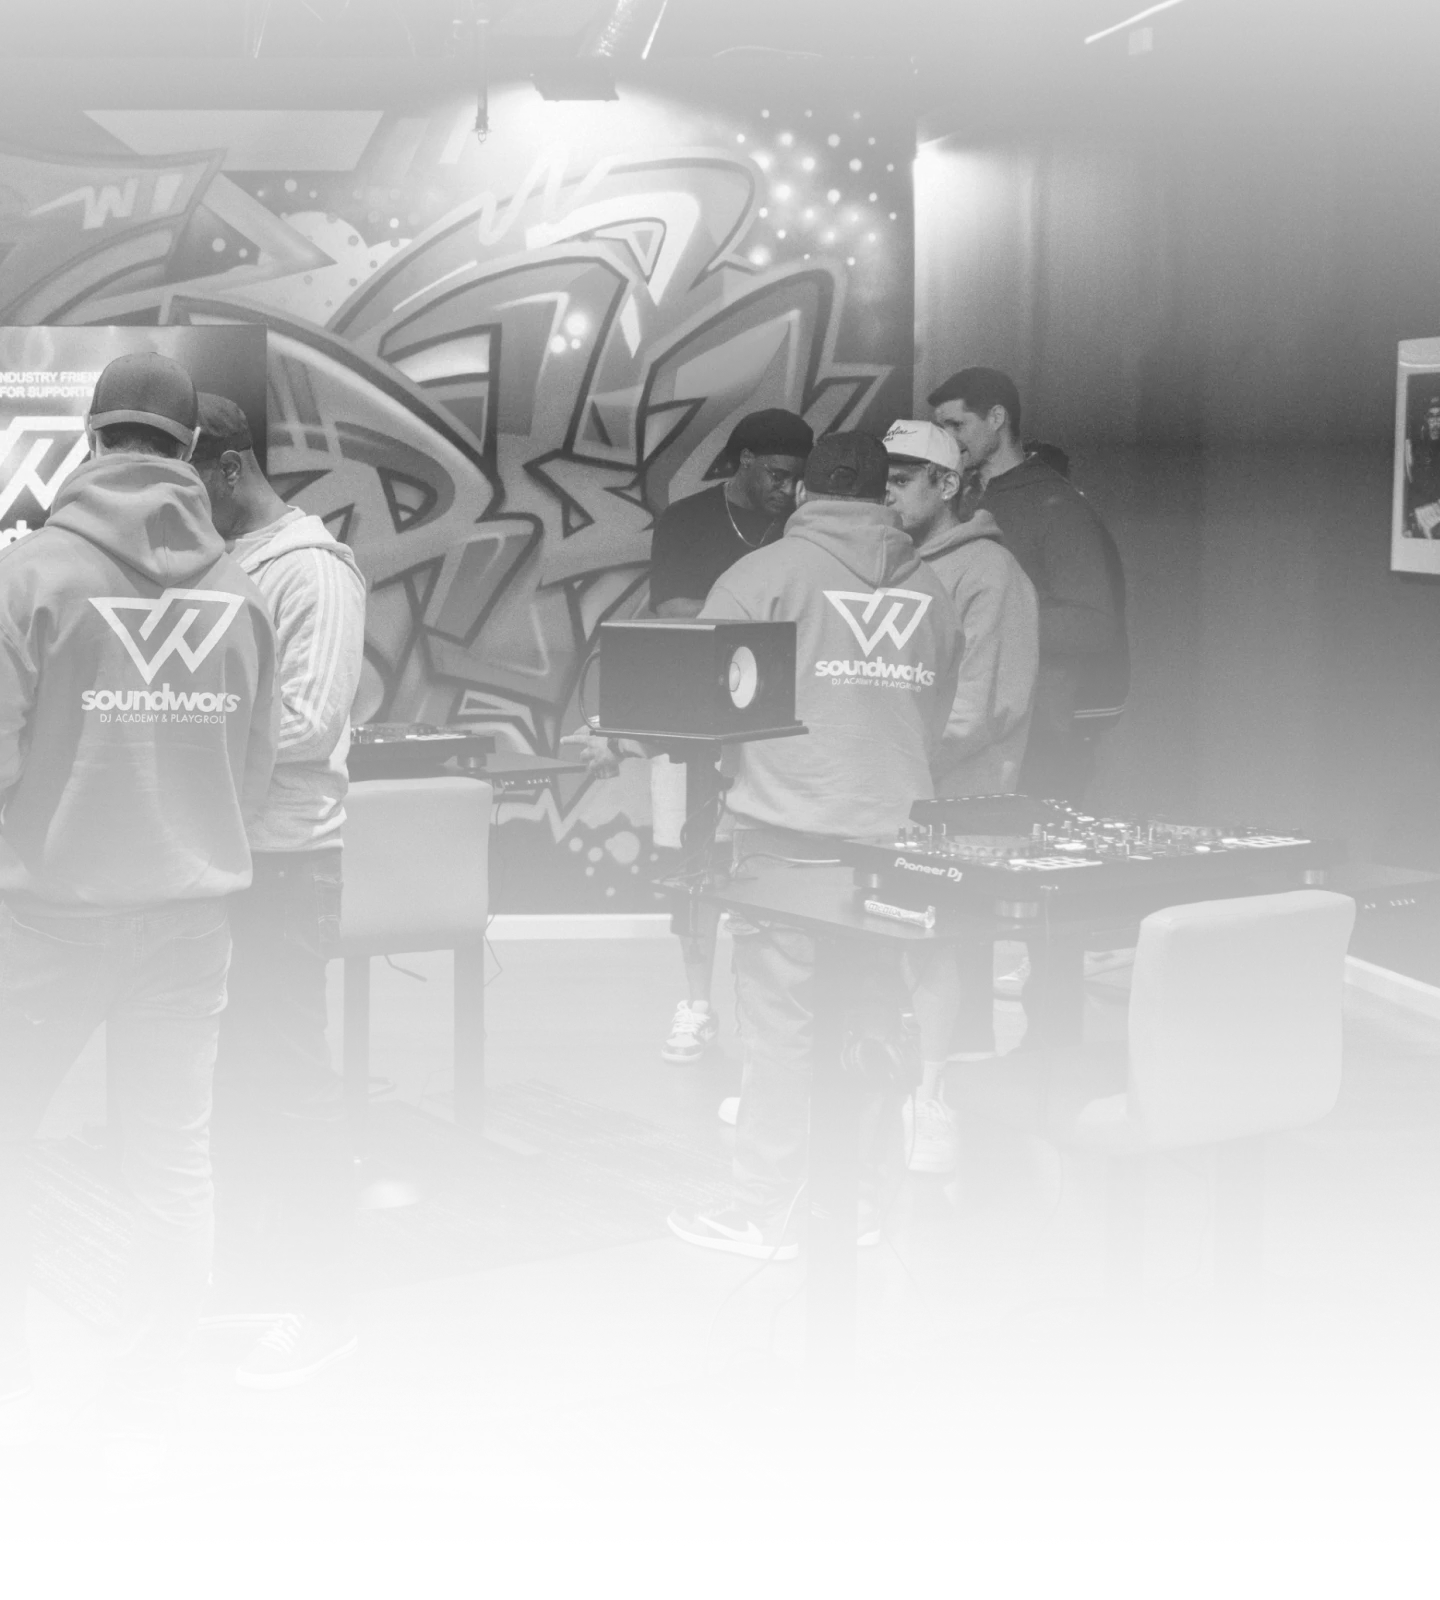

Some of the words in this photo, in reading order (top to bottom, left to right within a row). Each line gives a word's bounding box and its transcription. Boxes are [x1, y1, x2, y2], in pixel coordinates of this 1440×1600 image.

[61, 371, 102, 382] FRIEN
[0, 386, 23, 398] FOR
[26, 386, 94, 398] SUPPORTI
[831, 678, 841, 686] DJ
[81, 682, 242, 712] soundwors
[100, 713, 112, 723] DJ
[115, 713, 160, 723] ACADEMY
[161, 714, 168, 723] &
[170, 714, 226, 724] PLAYGROU
[894, 856, 946, 876] Pioneer
